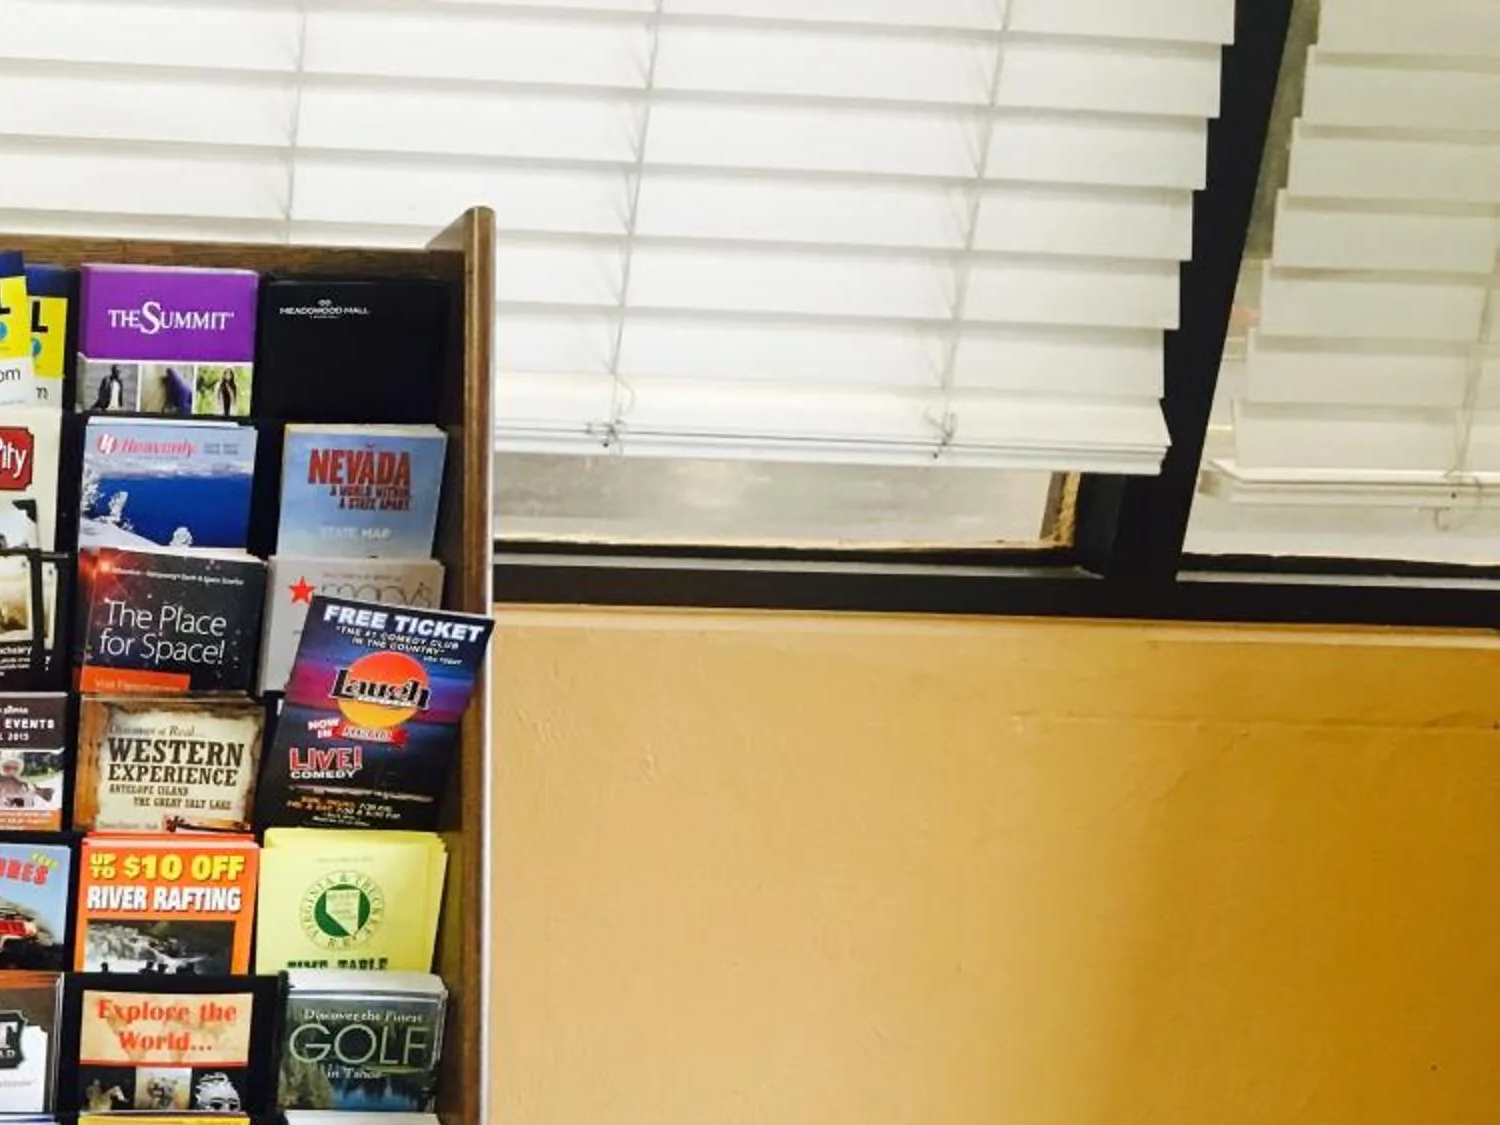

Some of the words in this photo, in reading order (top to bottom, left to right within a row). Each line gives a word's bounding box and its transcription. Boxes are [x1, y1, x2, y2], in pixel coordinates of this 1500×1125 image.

[307, 448, 412, 485] NEVADA
[105, 600, 152, 630] The
[159, 606, 227, 637] Place
[323, 605, 388, 629] FREE
[394, 615, 484, 642] TICKET
[100, 627, 135, 657] for
[141, 632, 225, 665] Space!
[5, 718, 55, 729] EVENTS
[108, 738, 245, 767] WESTERN
[289, 746, 363, 770] LIVE!
[108, 764, 238, 787] EXPERIENCE
[291, 769, 355, 779] COMEDY
[90, 853, 114, 865] UP
[123, 855, 181, 880] $10
[192, 855, 245, 881] OFF
[90, 867, 115, 879] TO
[88, 887, 147, 911] RIVER
[154, 887, 242, 913] RAFTING
[99, 1000, 192, 1021] Explore
[199, 1000, 237, 1022] the
[289, 1024, 428, 1065] GOLF
